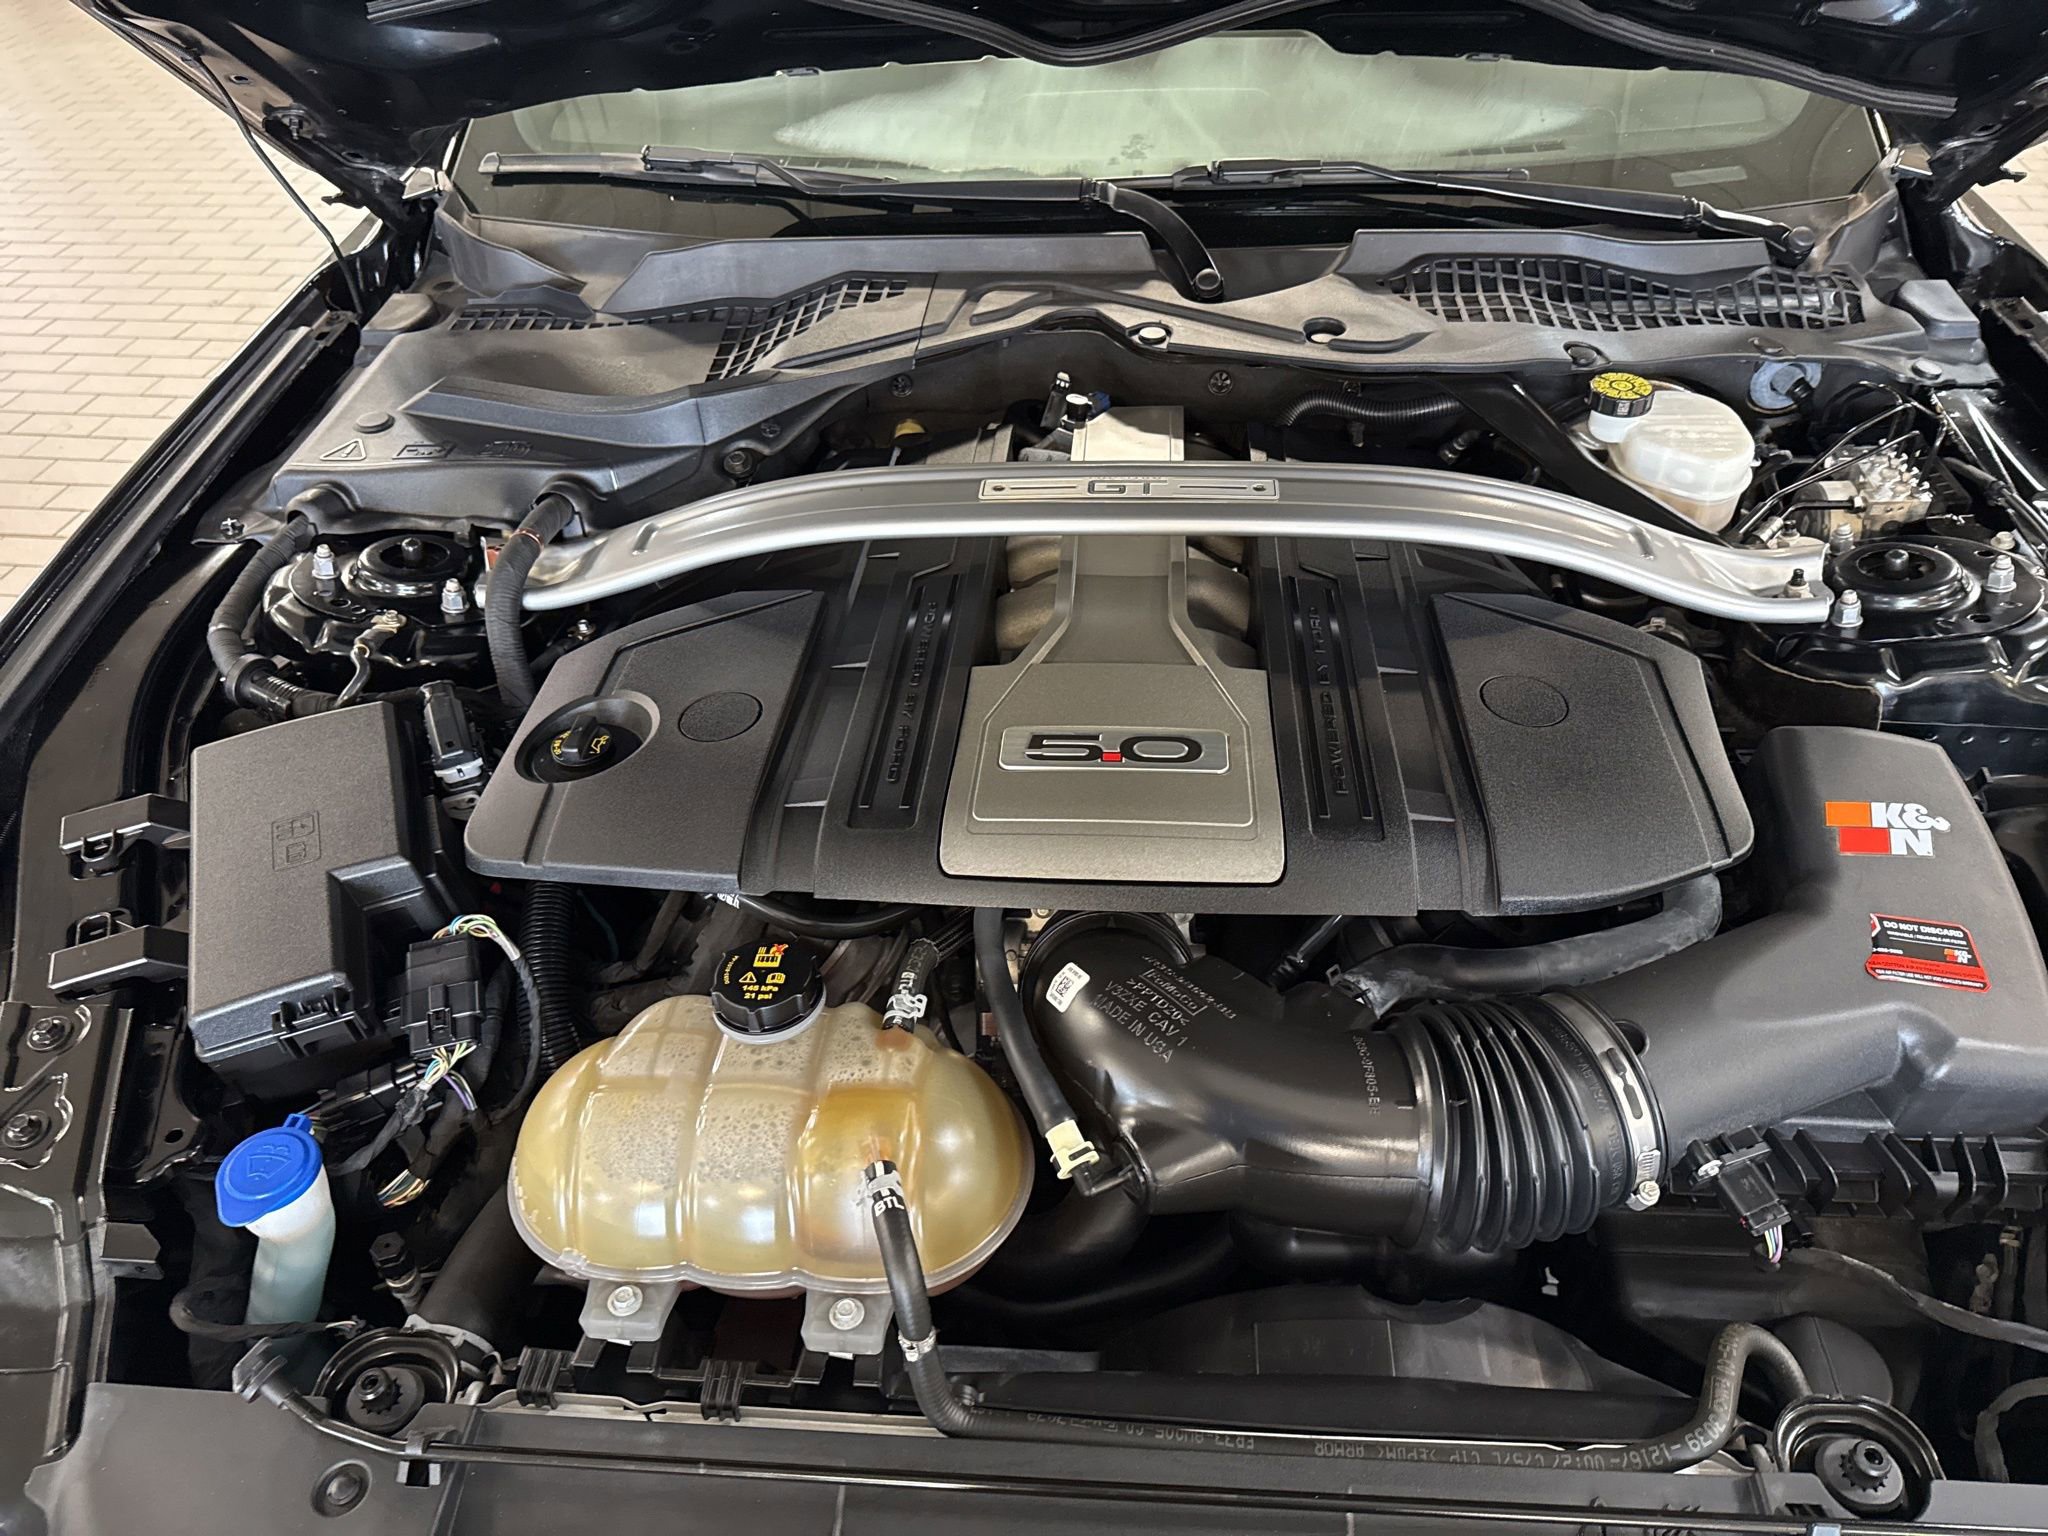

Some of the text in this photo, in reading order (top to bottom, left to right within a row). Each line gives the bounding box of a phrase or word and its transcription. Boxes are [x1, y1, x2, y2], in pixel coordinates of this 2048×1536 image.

[1087, 479, 1168, 496] GT
[1025, 734, 1203, 764] 5.0
[1883, 920, 1964, 938] DO NOT DISCARD
[1093, 993, 1132, 1025] MADE
[1127, 1019, 1147, 1037] IN
[1144, 1031, 1173, 1063] USA
[873, 1195, 905, 1217] BTL
[1314, 1441, 1365, 1458] ARMOR
